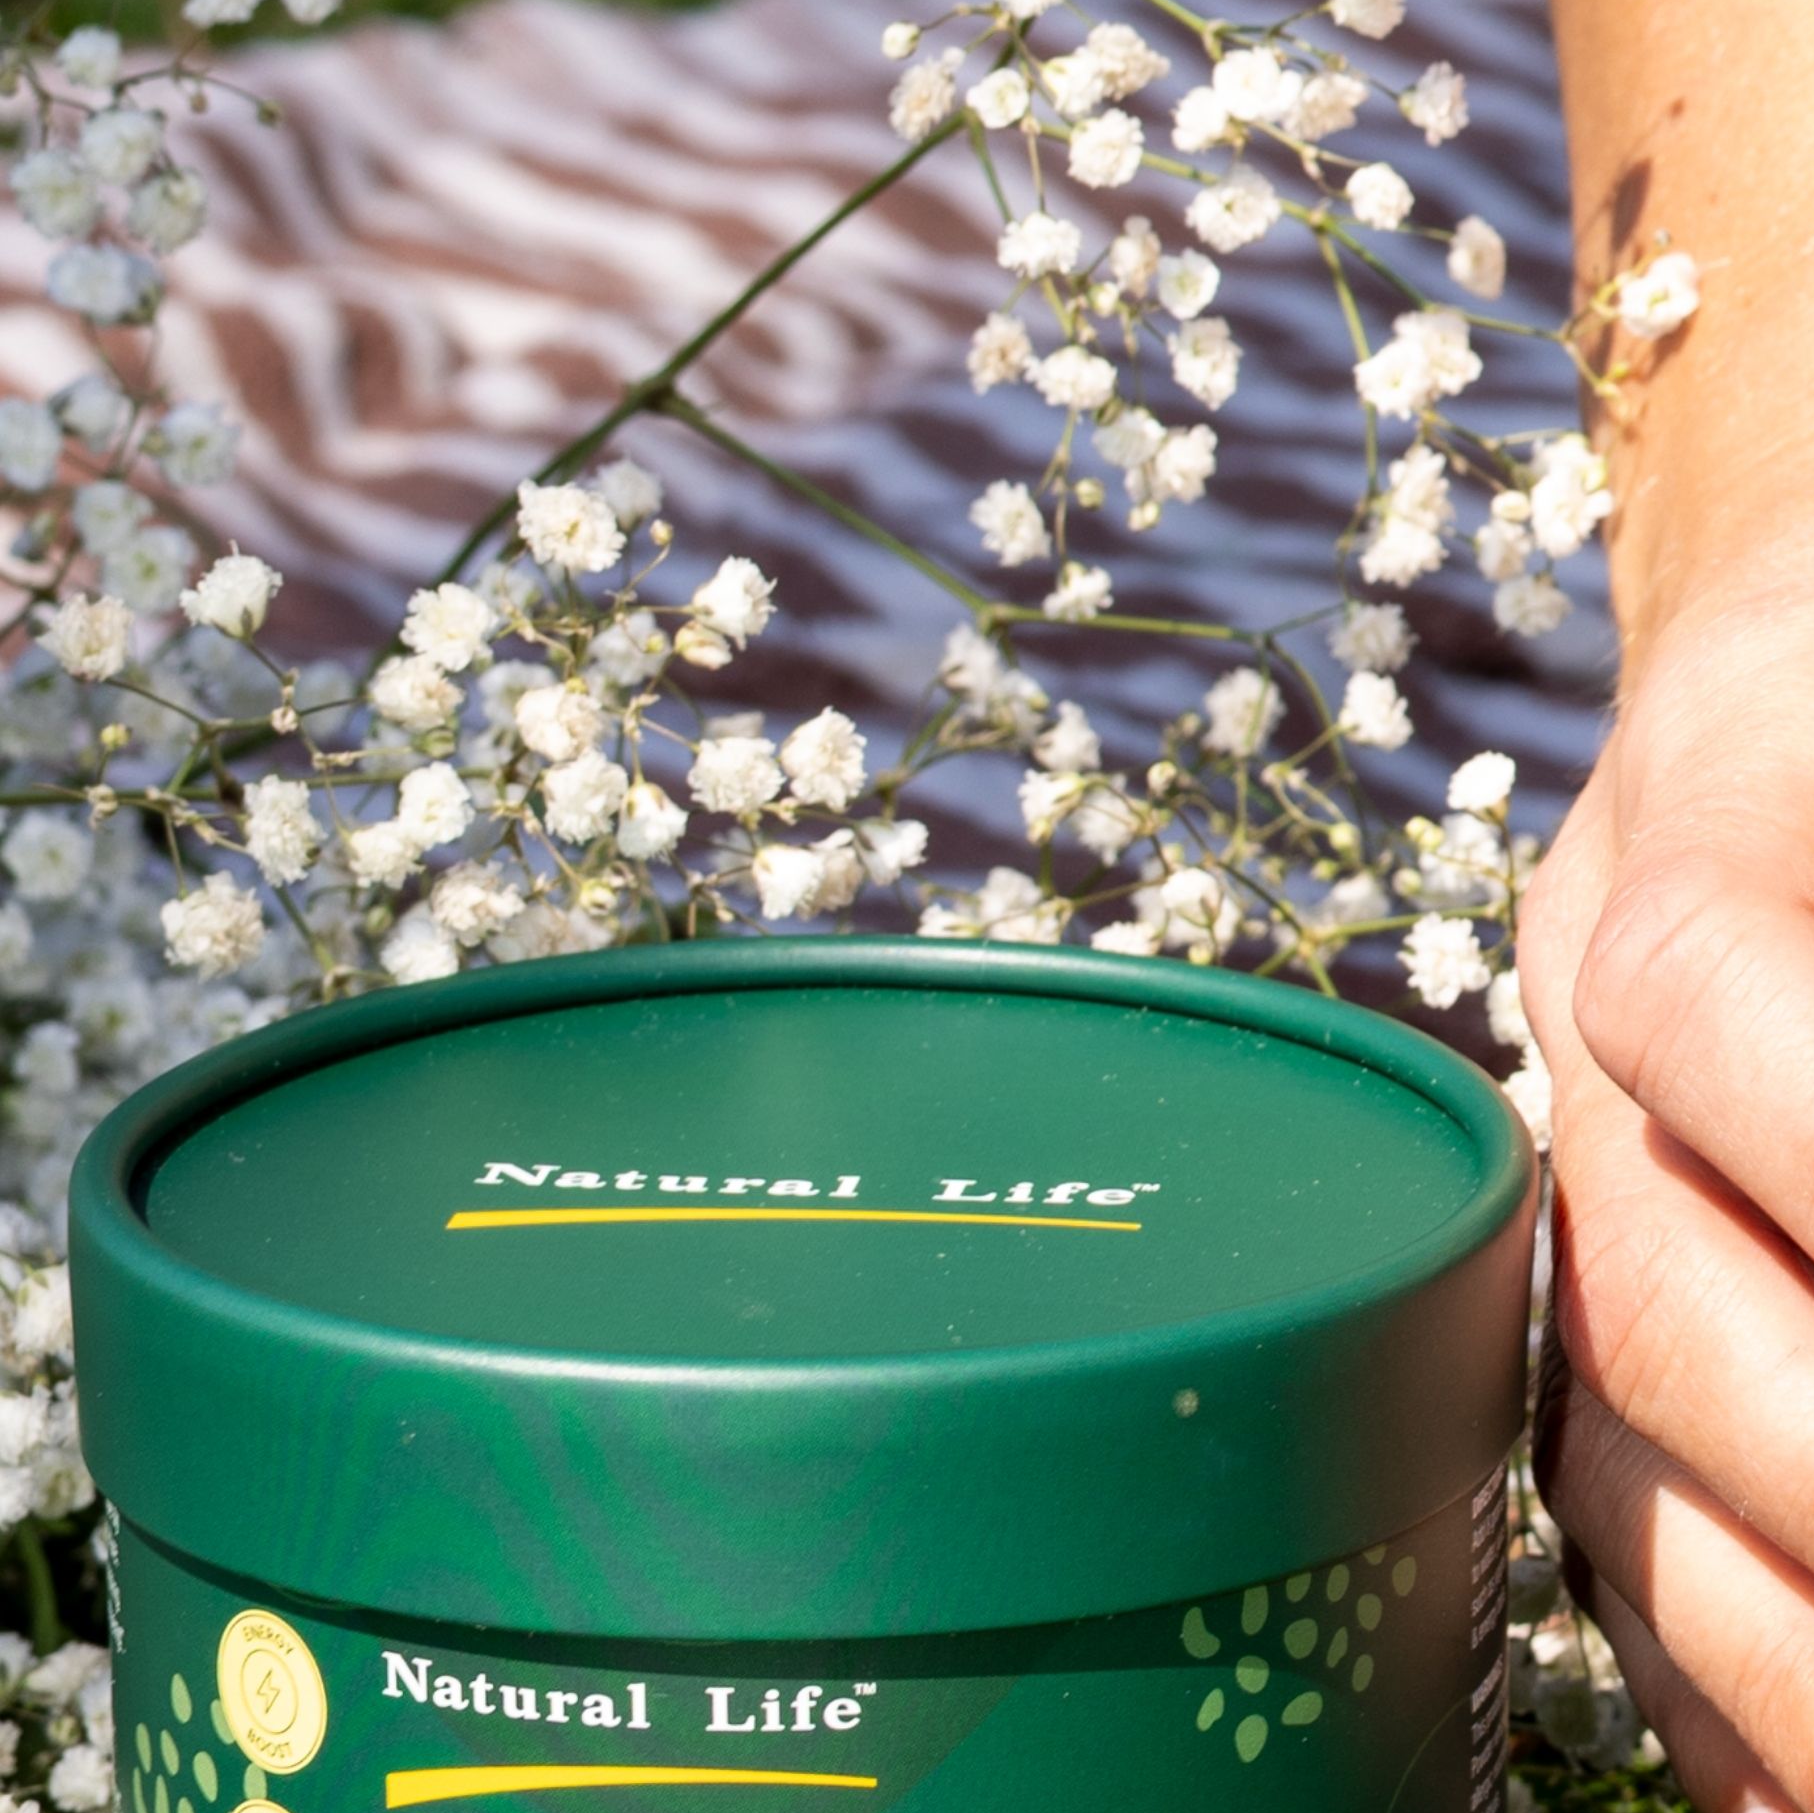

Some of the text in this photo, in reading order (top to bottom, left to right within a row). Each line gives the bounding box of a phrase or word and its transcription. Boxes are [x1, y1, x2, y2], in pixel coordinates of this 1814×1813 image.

[474, 1162, 861, 1199] Natural
[242, 1624, 295, 1656] ENERGY
[381, 1651, 651, 1730] Natural
